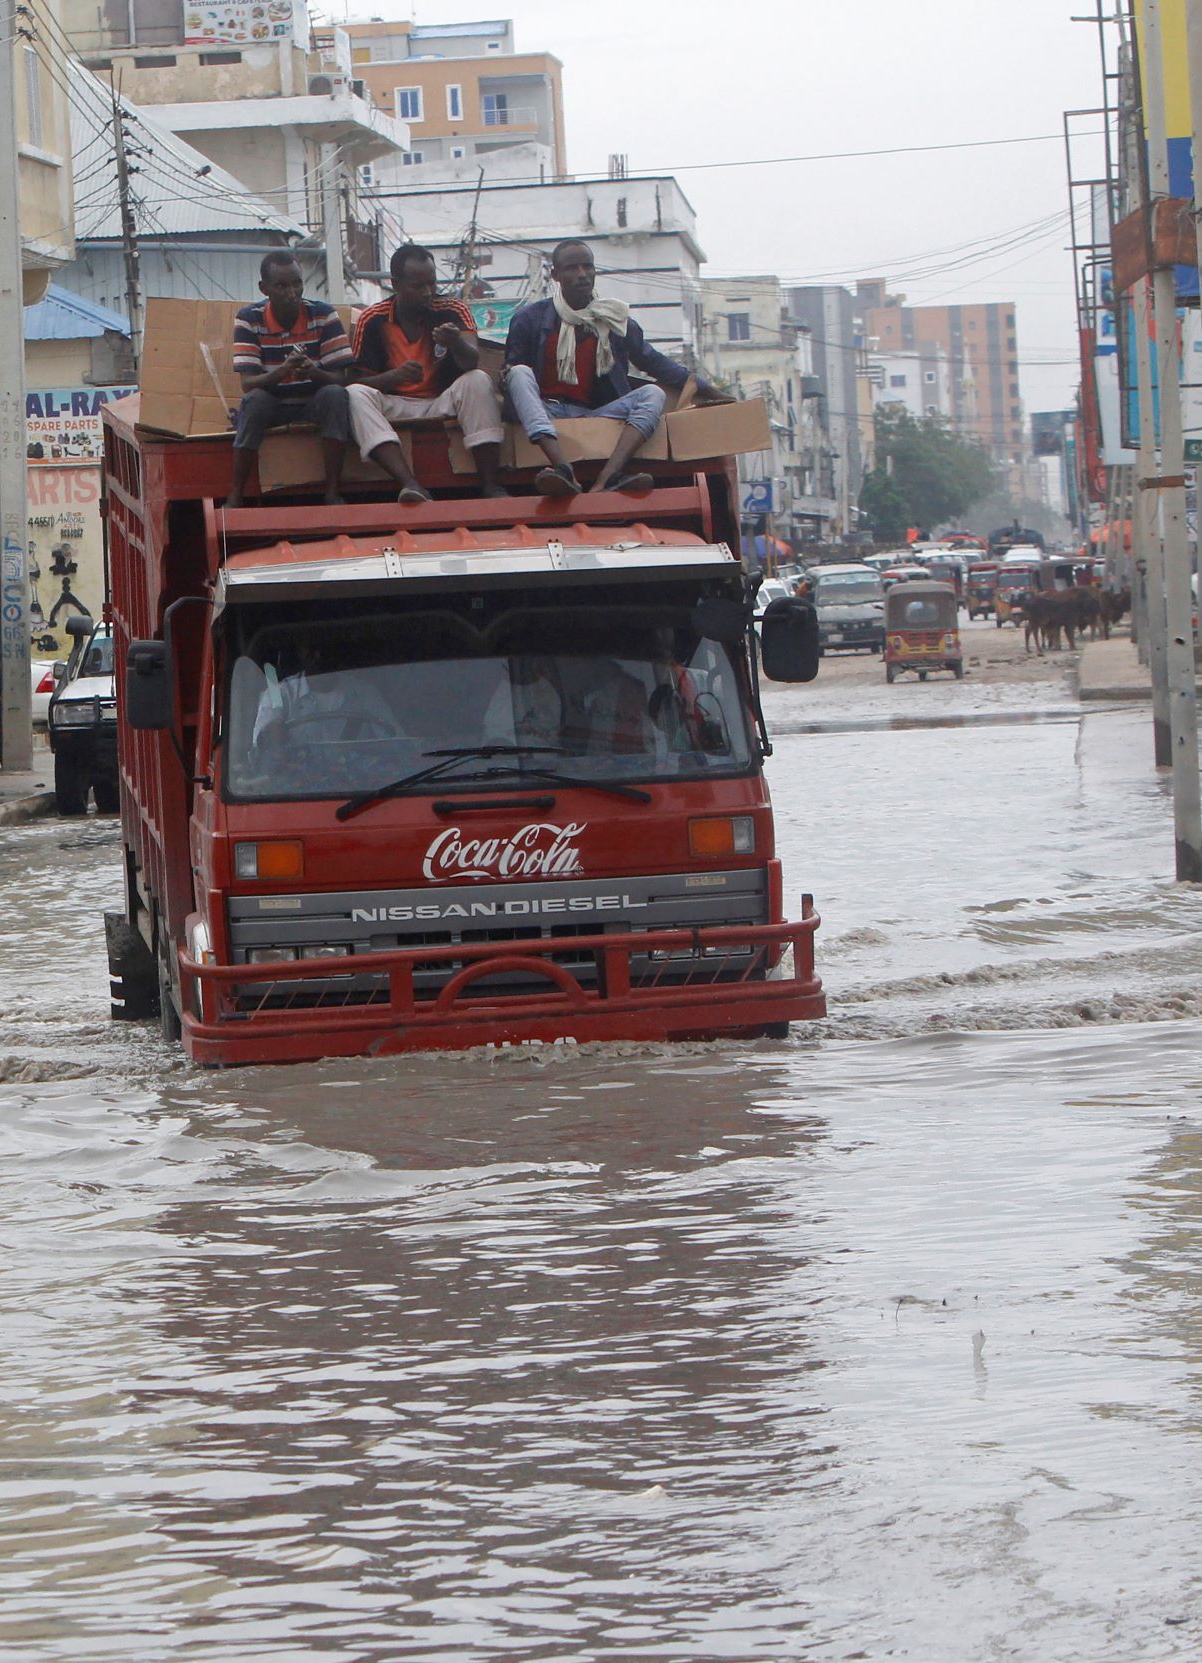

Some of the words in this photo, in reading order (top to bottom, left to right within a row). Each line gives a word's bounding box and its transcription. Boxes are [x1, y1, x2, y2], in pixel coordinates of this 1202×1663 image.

[27, 420, 61, 432] SPARE
[65, 419, 98, 430] PARTS
[423, 822, 589, 881] Coca-Cola
[351, 901, 497, 924] NISSAN
[504, 895, 648, 916] DIESEL
